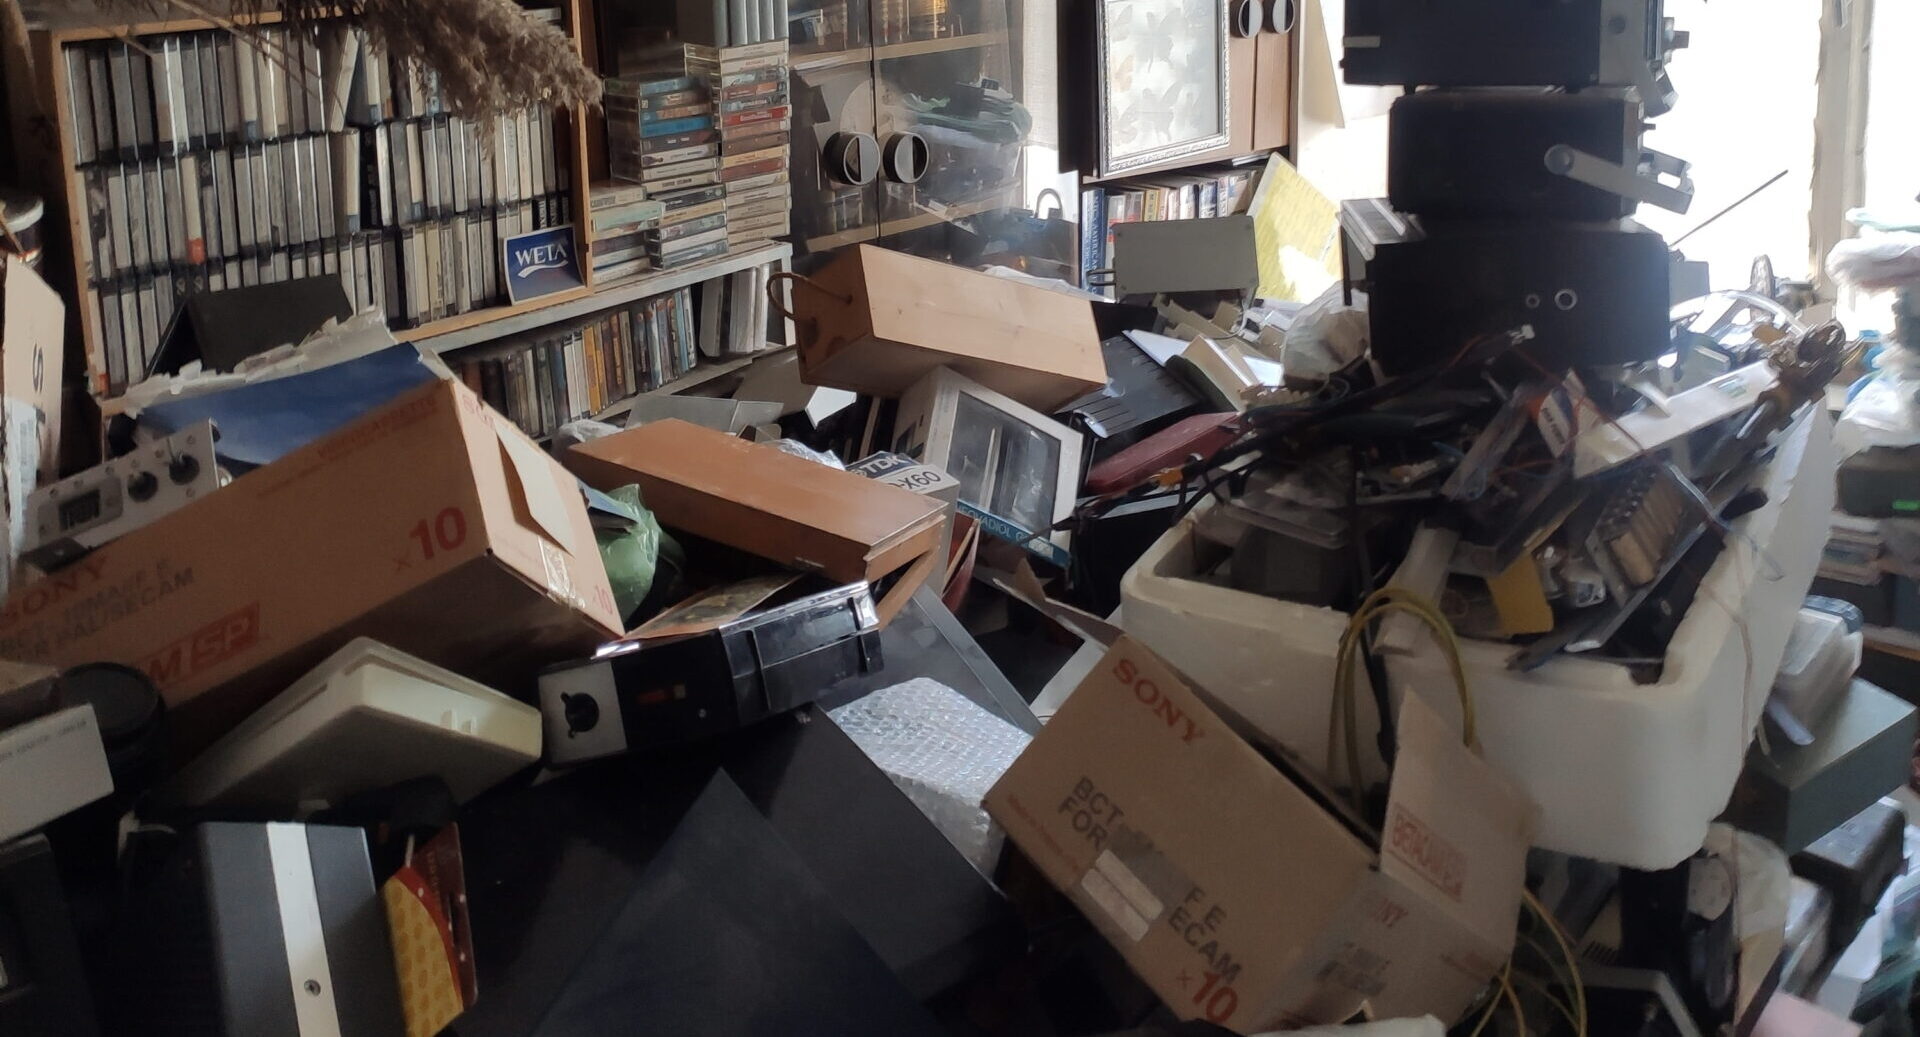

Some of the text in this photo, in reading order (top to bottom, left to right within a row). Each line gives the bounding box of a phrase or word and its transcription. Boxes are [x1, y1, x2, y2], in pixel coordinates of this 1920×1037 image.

[515, 243, 568, 267] WETA
[860, 455, 908, 474] TDK
[889, 471, 941, 489] -X60
[1111, 656, 1207, 747] SONY
[1074, 776, 1125, 826] BCT
[1058, 797, 1107, 852] FOR
[1167, 909, 1243, 981] ECAM
